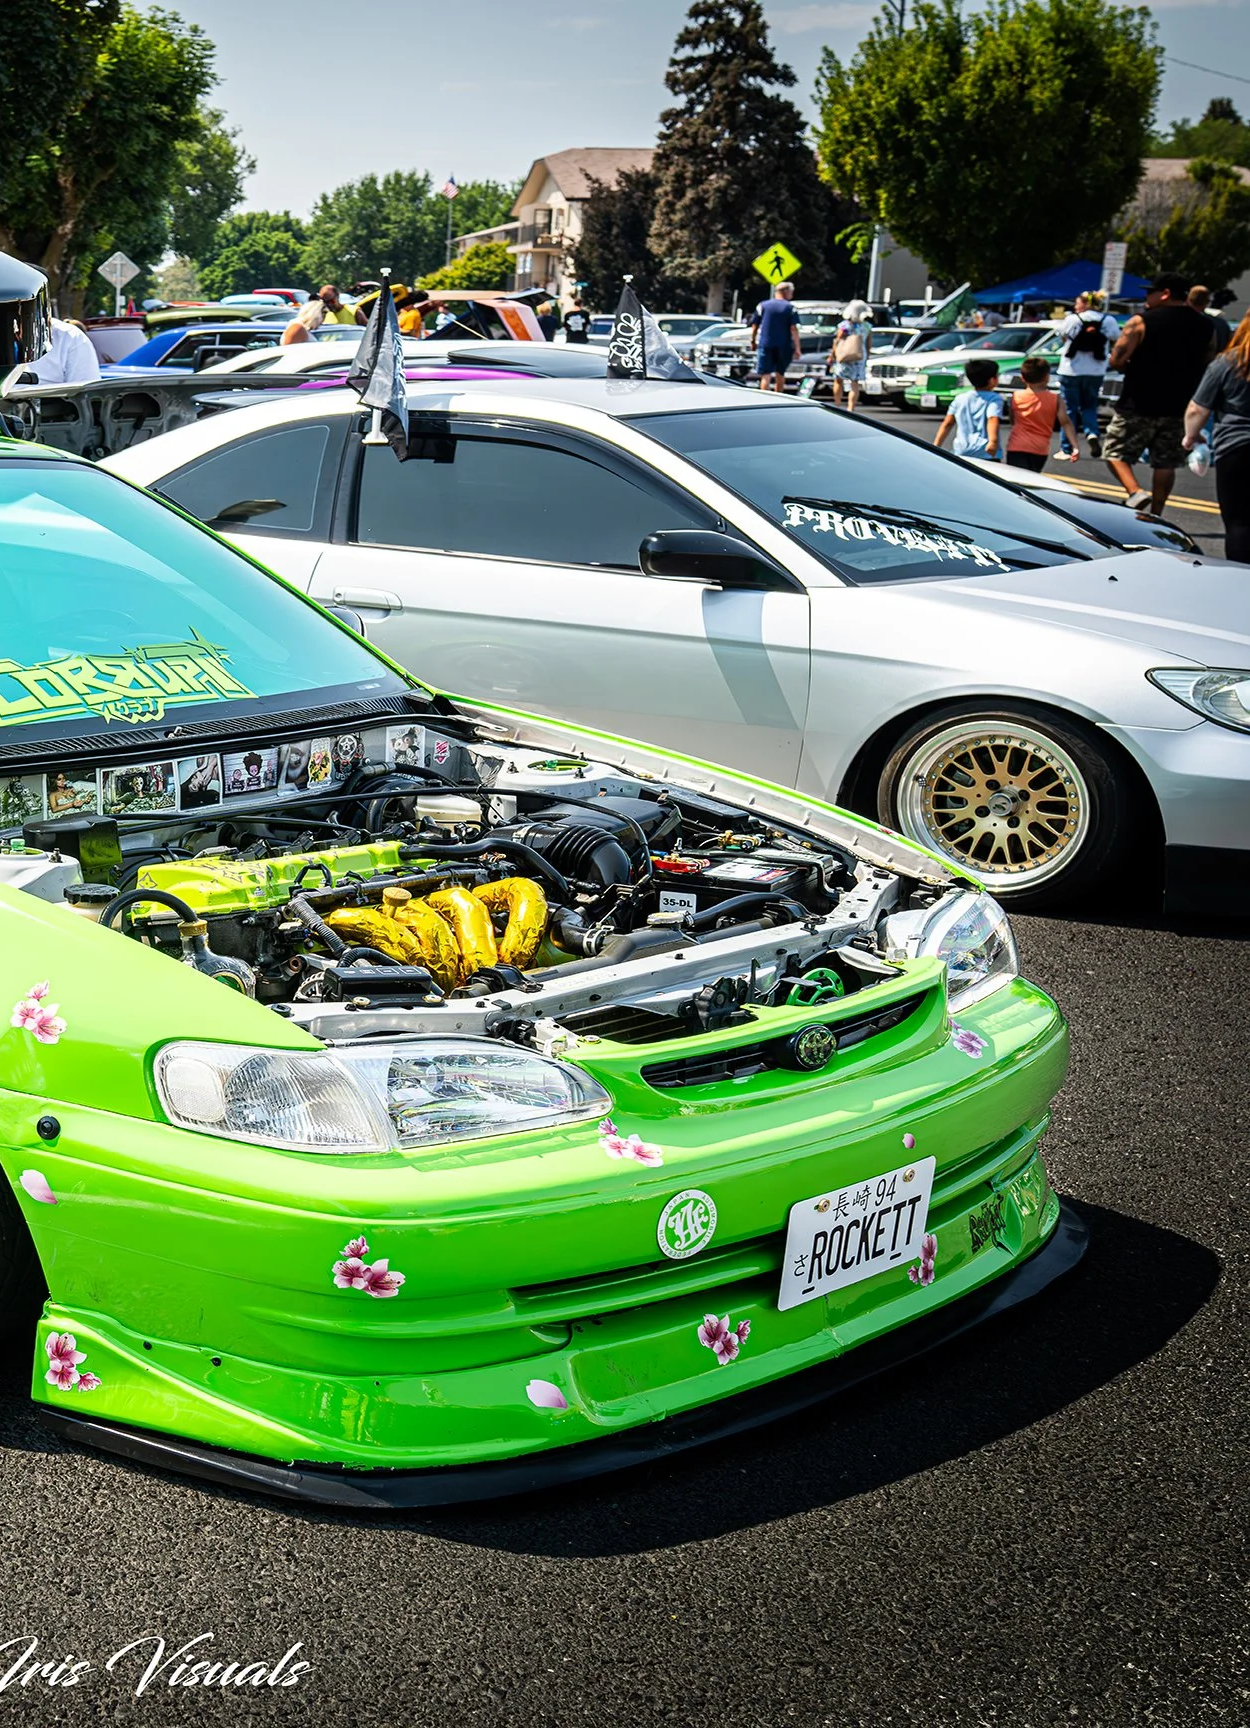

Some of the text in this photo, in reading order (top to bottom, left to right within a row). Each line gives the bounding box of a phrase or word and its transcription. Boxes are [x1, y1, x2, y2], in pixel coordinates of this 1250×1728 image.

[662, 897, 694, 908] 35-DL
[832, 1173, 898, 1222] 長崎 94
[794, 1194, 922, 1284] さ ROCKETT
